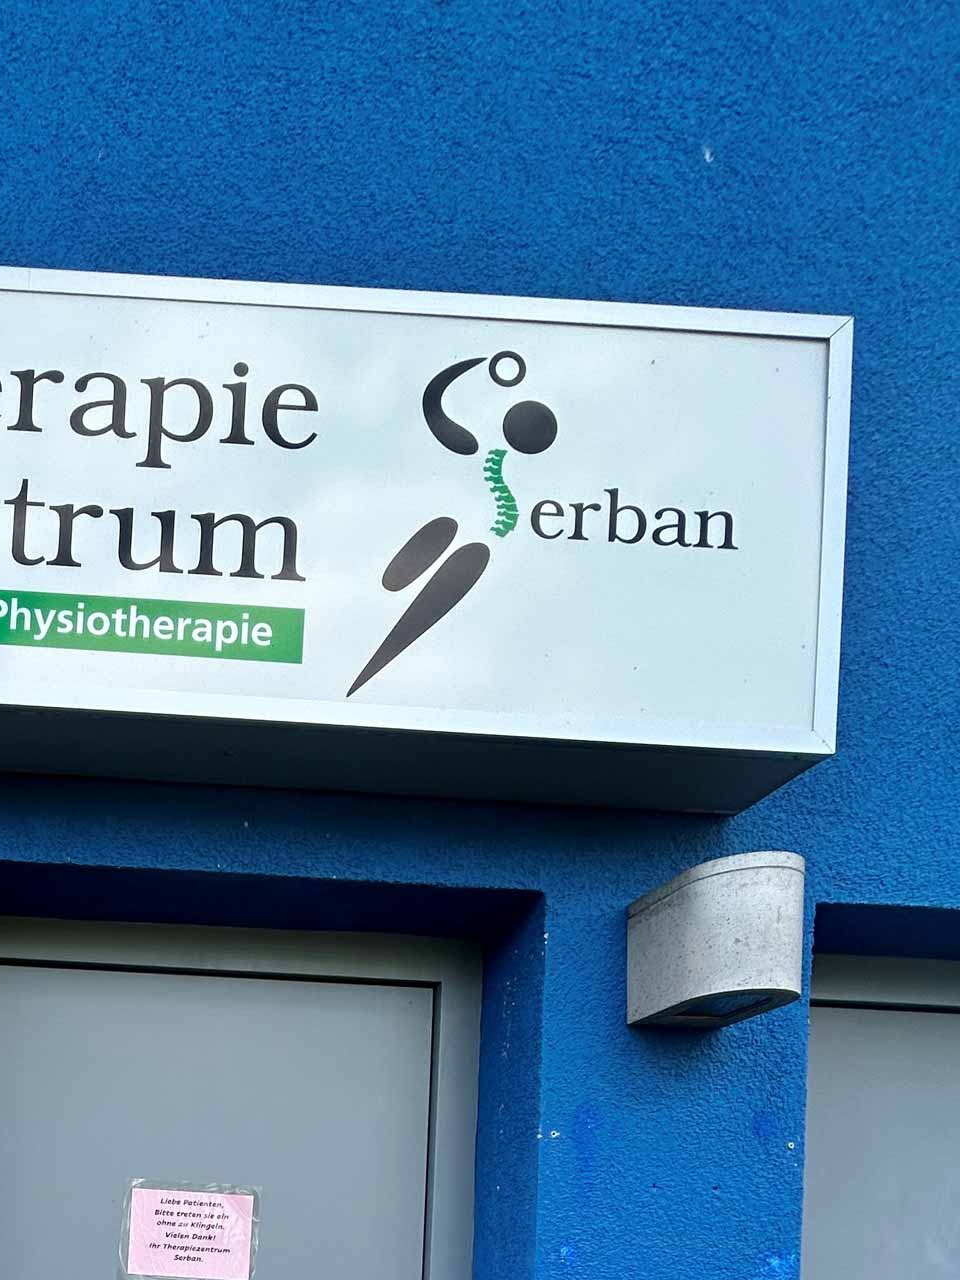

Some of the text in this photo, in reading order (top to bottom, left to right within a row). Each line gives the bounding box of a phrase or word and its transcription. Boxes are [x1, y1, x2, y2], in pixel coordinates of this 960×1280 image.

[160, 1198, 181, 1206] Liebe
[154, 1209, 174, 1217] Bitte
[176, 1210, 202, 1218] treten
[216, 1212, 229, 1220] ein
[165, 1231, 216, 1241] Vielen Dank!
[163, 1243, 231, 1254] Therapiezentrum
